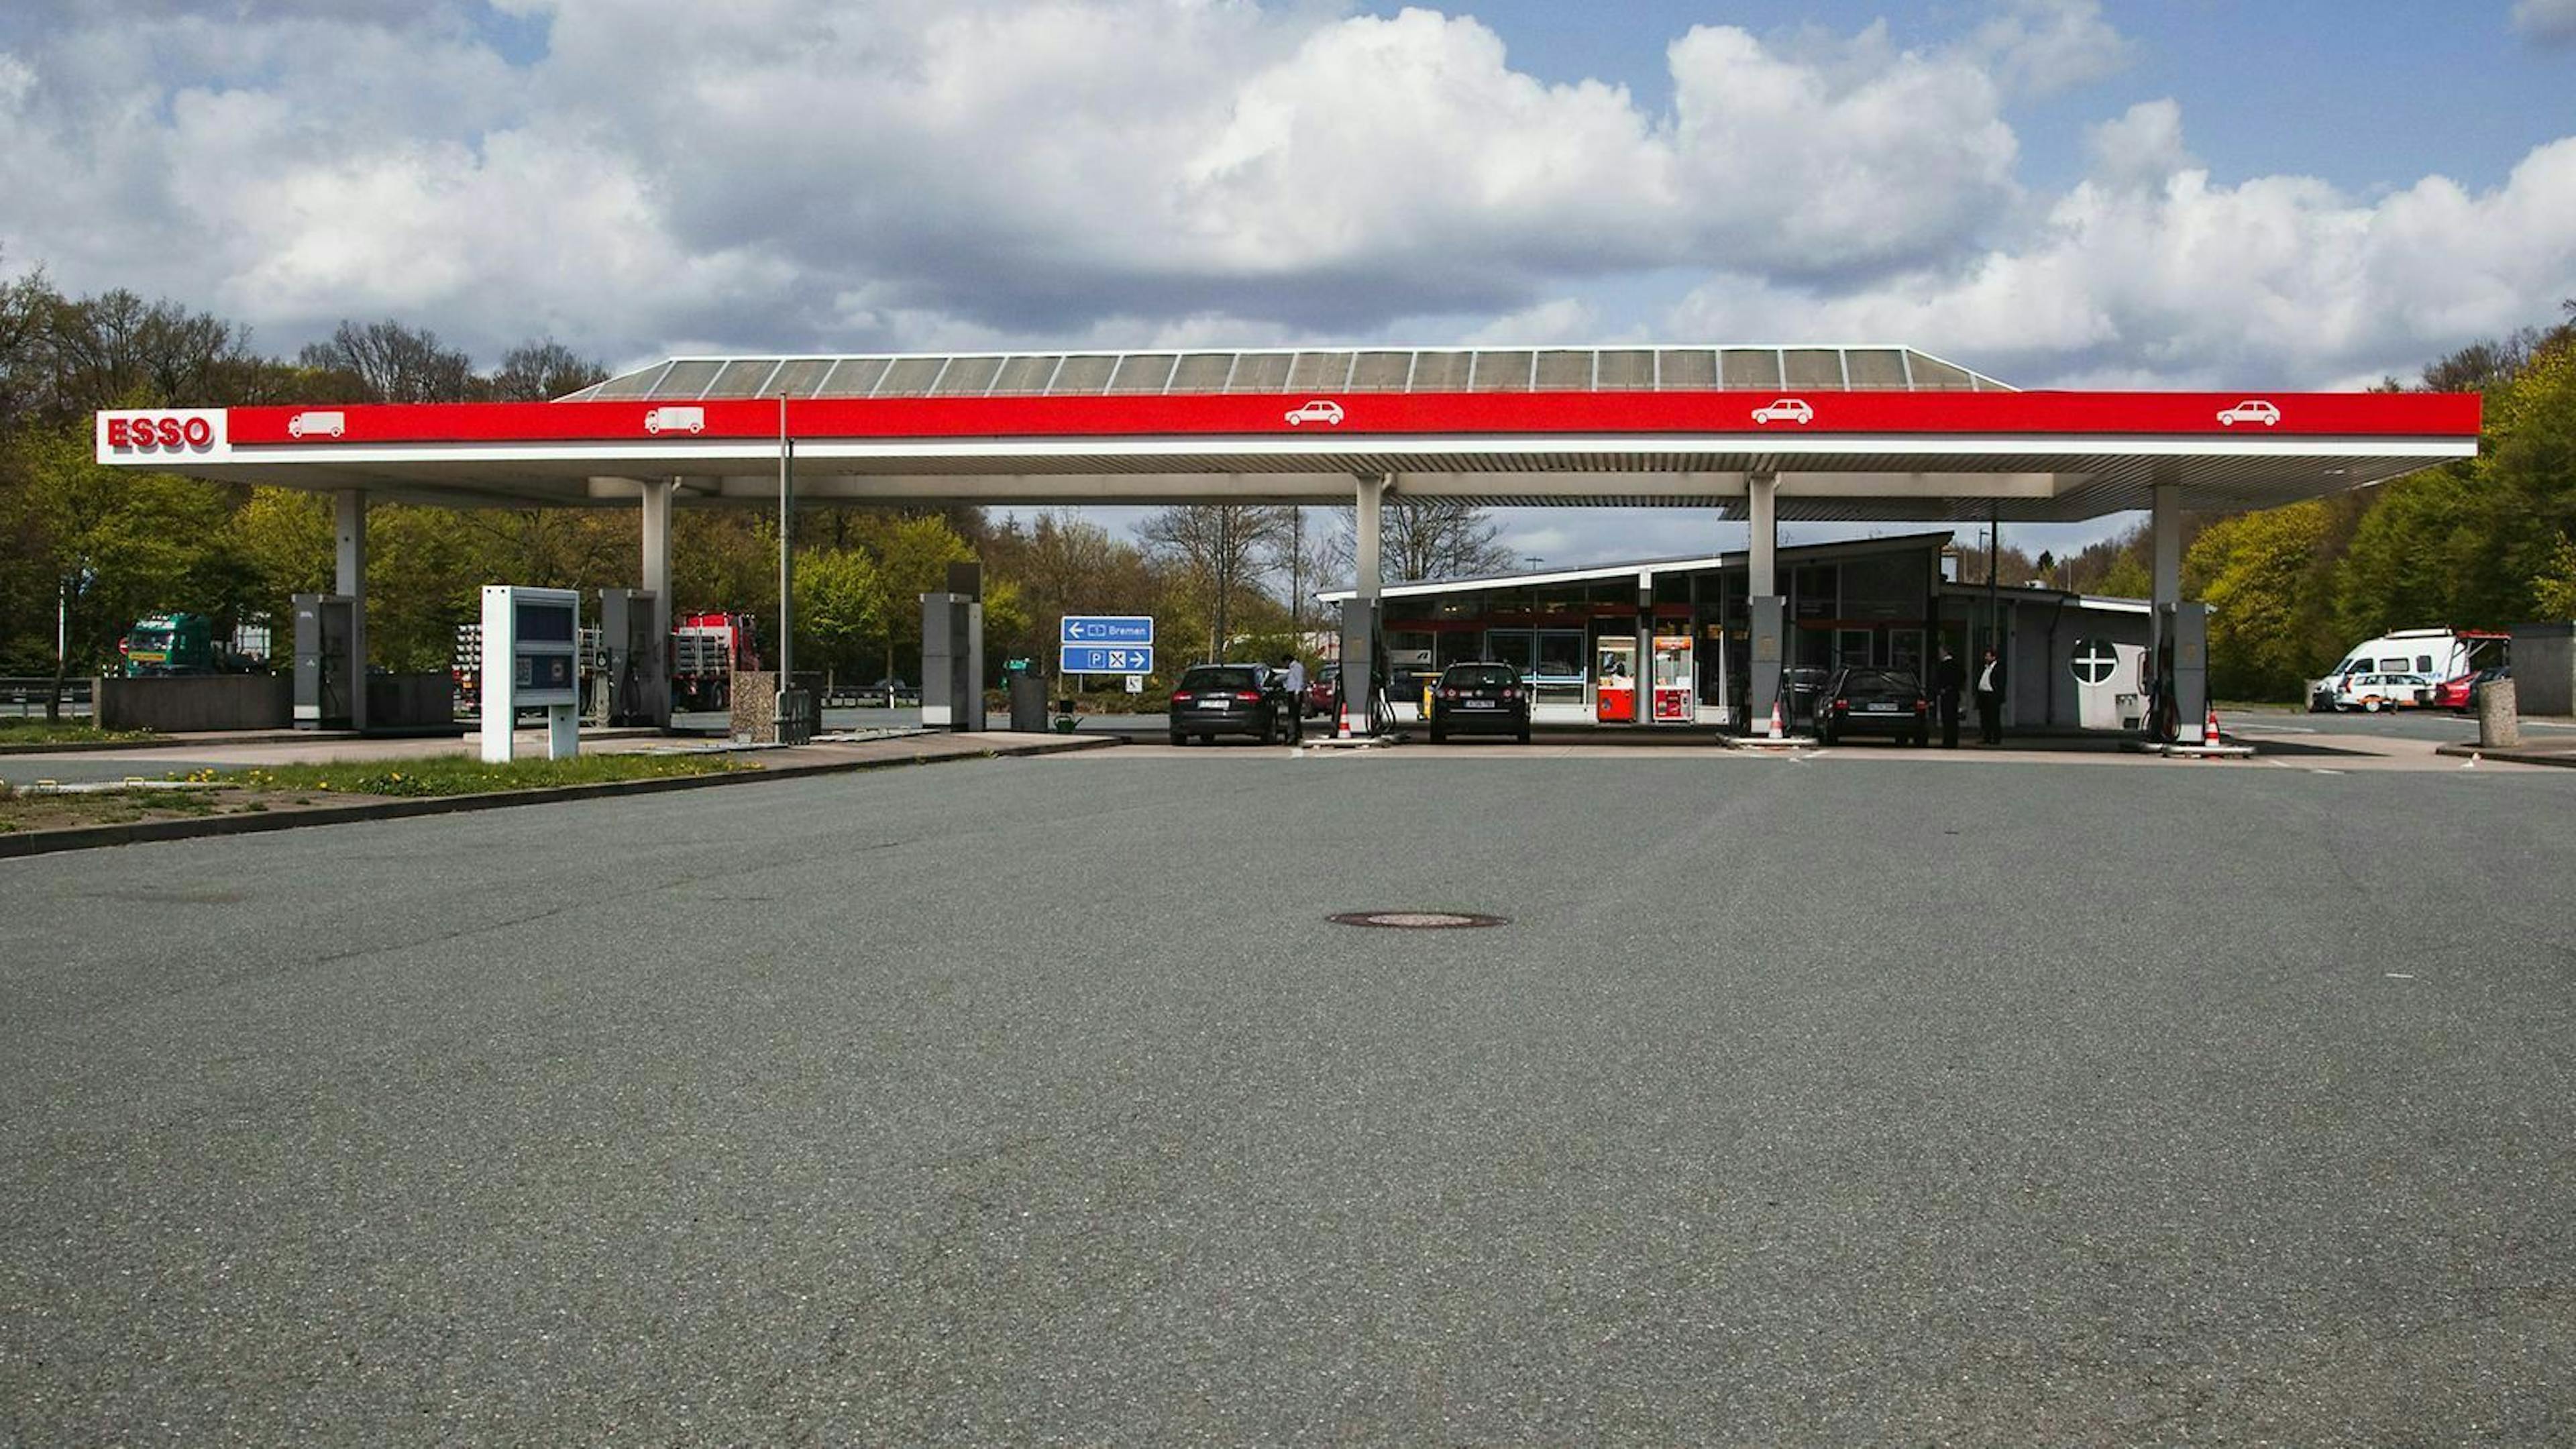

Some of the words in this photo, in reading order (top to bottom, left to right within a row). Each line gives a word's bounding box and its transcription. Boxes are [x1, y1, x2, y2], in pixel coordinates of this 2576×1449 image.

[108, 417, 211, 447] ESSO
[1108, 626, 1146, 635] Bremen
[1092, 653, 1101, 665] P
